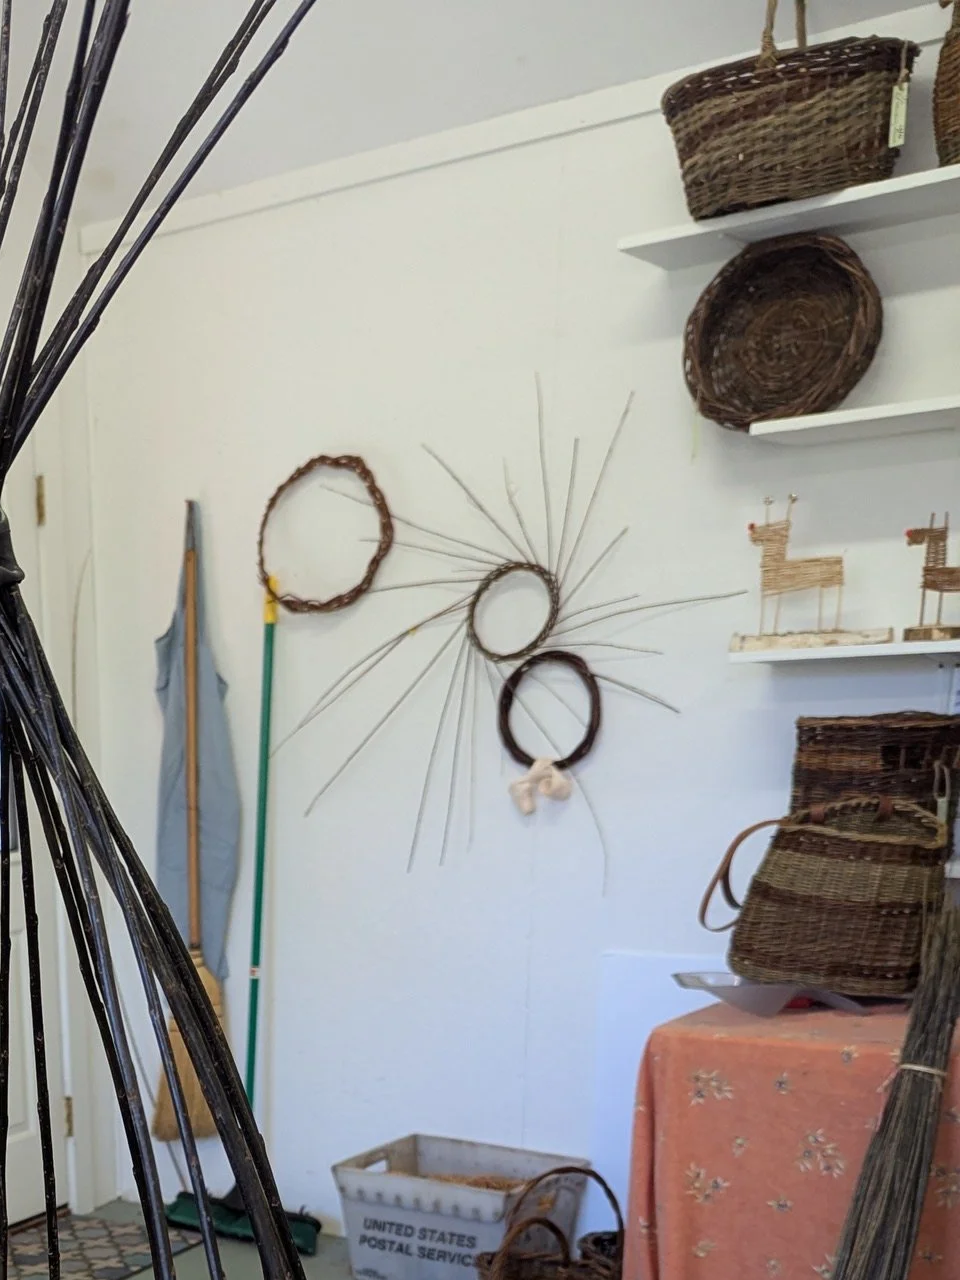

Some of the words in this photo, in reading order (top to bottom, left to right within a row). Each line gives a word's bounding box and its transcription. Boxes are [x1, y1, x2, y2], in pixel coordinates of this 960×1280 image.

[358, 1234, 413, 1257] POSTAL
[363, 1217, 415, 1238] UNITED
[417, 1227, 477, 1249] STATES
